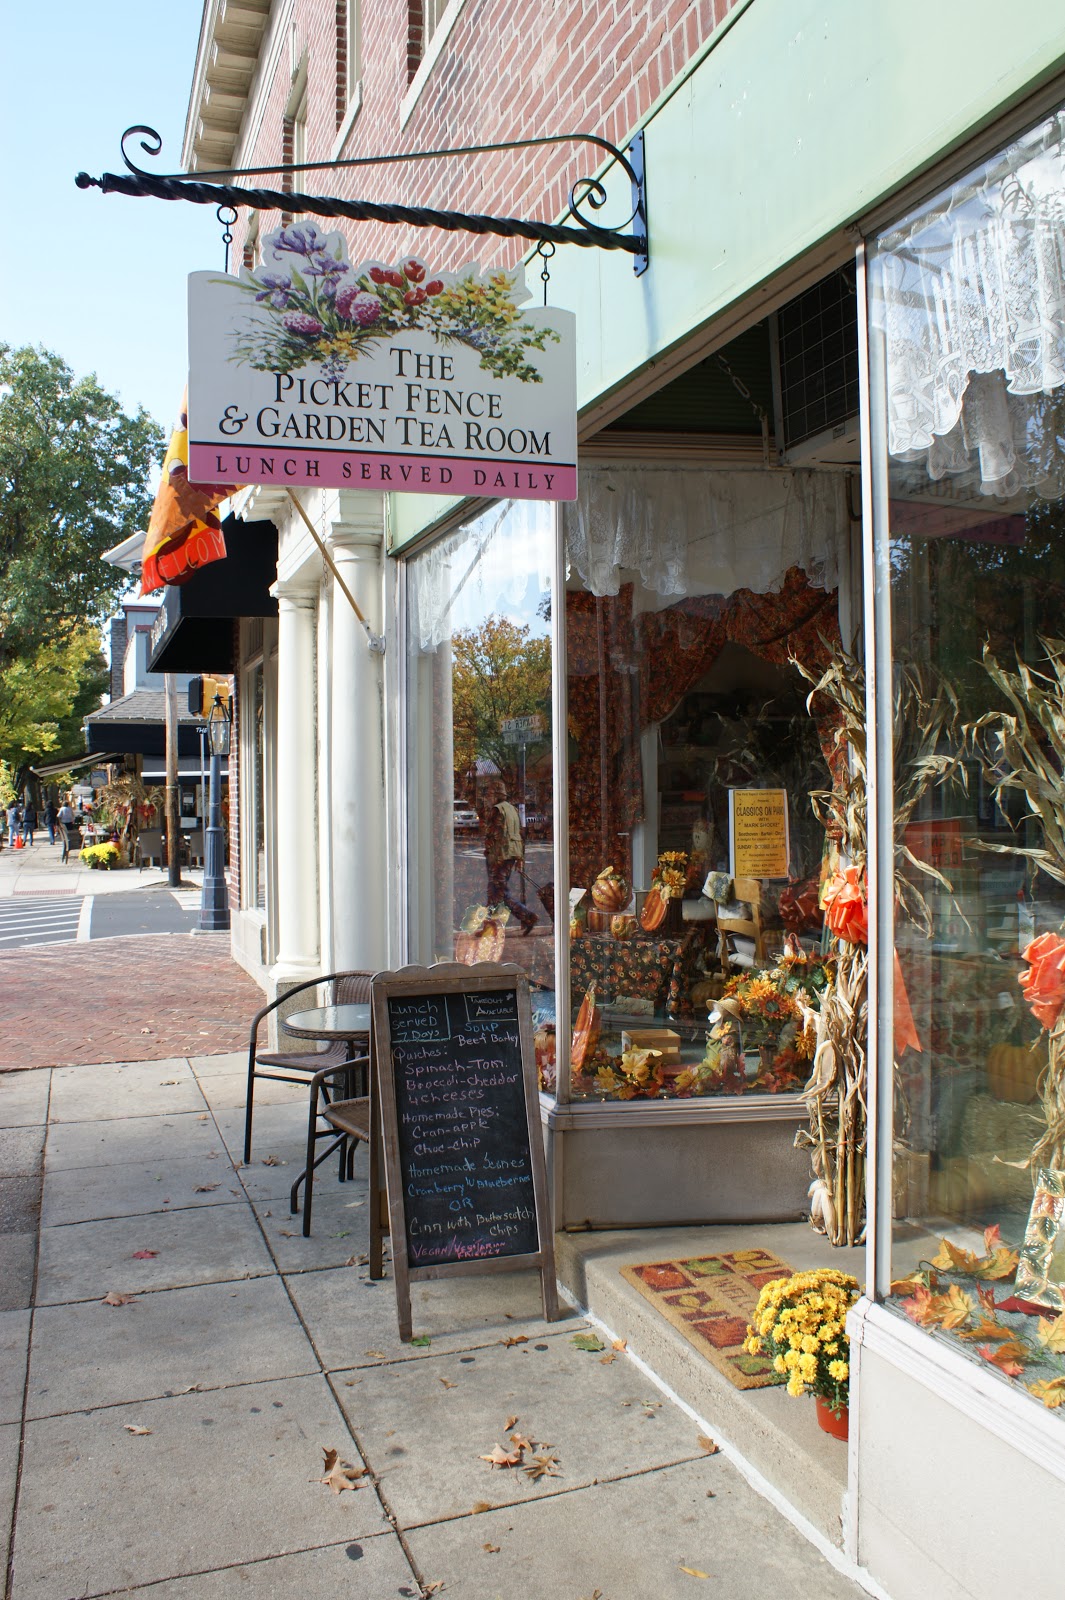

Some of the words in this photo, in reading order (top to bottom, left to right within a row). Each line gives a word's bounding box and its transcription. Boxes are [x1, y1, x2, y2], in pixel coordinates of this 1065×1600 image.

[389, 346, 455, 381] THE
[273, 372, 394, 411] PICKET
[405, 383, 503, 419] FENCE
[218, 405, 249, 436] &
[256, 407, 386, 445] GARDEN
[395, 416, 454, 450] TEA
[464, 421, 553, 456] ROOM
[215, 454, 321, 478] LUNCH
[342, 461, 453, 485] SERVED
[474, 468, 556, 491] DAILY
[389, 1000, 439, 1015] Lunch
[452, 1034, 488, 1047] Beef
[449, 1197, 474, 1212] OR
